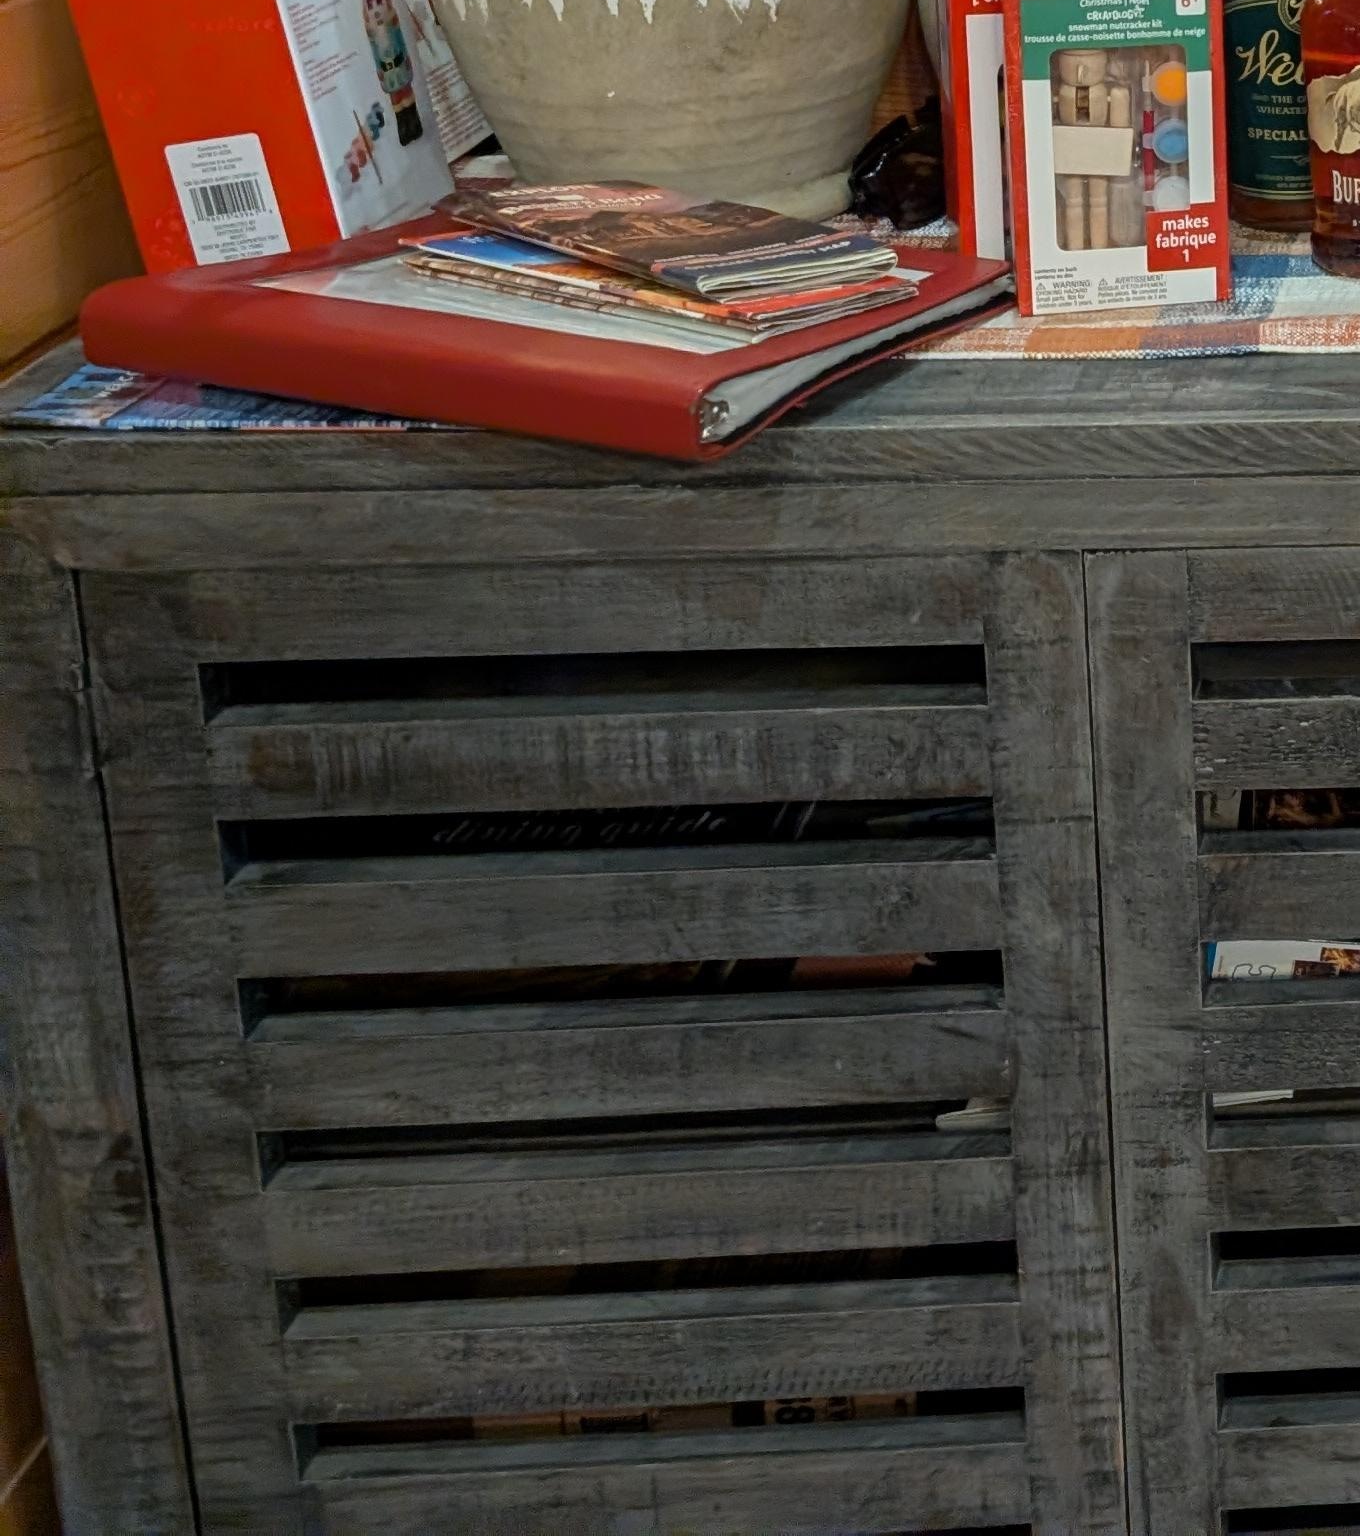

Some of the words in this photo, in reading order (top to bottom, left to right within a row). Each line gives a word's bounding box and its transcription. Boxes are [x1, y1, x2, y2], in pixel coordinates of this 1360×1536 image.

[1068, 23, 1108, 32] snowman
[1110, 21, 1150, 31] nutcracker
[1152, 19, 1163, 28] kit
[1024, 35, 1055, 43] trousse
[1056, 33, 1066, 42] de
[1068, 31, 1125, 41] casse-noisette
[1127, 29, 1171, 39] bonhomme
[1173, 28, 1183, 37] de
[1184, 27, 1206, 38] neige
[1270, 95, 1293, 104] THE
[1248, 128, 1307, 141] SPECIAL
[1162, 215, 1209, 231] makes
[1155, 232, 1216, 249] fabrique
[1182, 249, 1190, 262] 1
